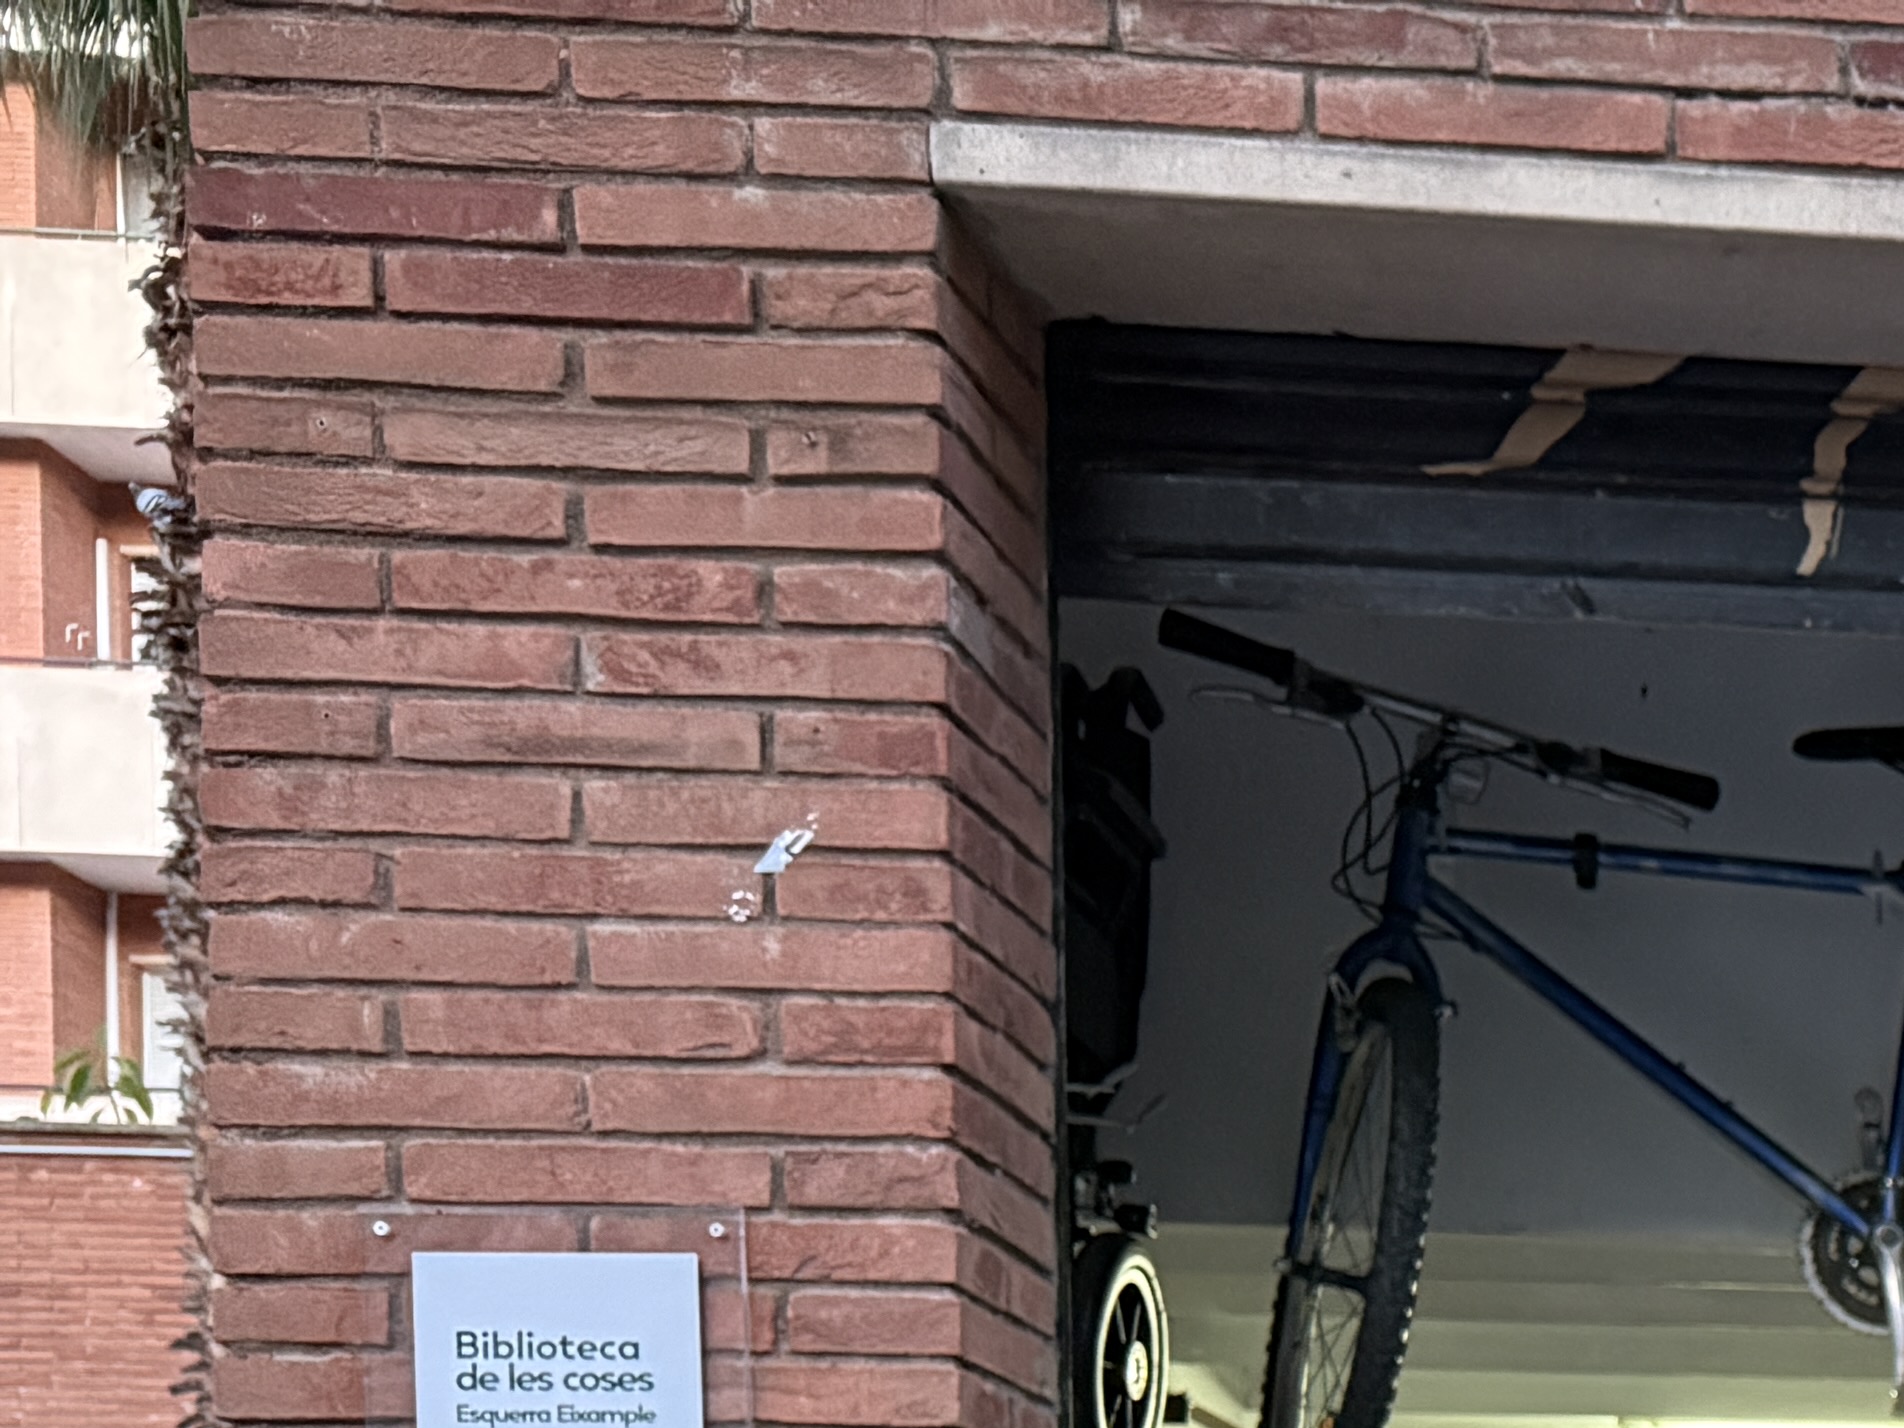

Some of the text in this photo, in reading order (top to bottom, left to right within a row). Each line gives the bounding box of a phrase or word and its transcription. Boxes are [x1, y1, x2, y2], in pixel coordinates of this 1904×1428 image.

[456, 1330, 640, 1360] Biblioteca
[456, 1362, 654, 1391] de les coses
[456, 1403, 657, 1428] Esquerra Eixample
